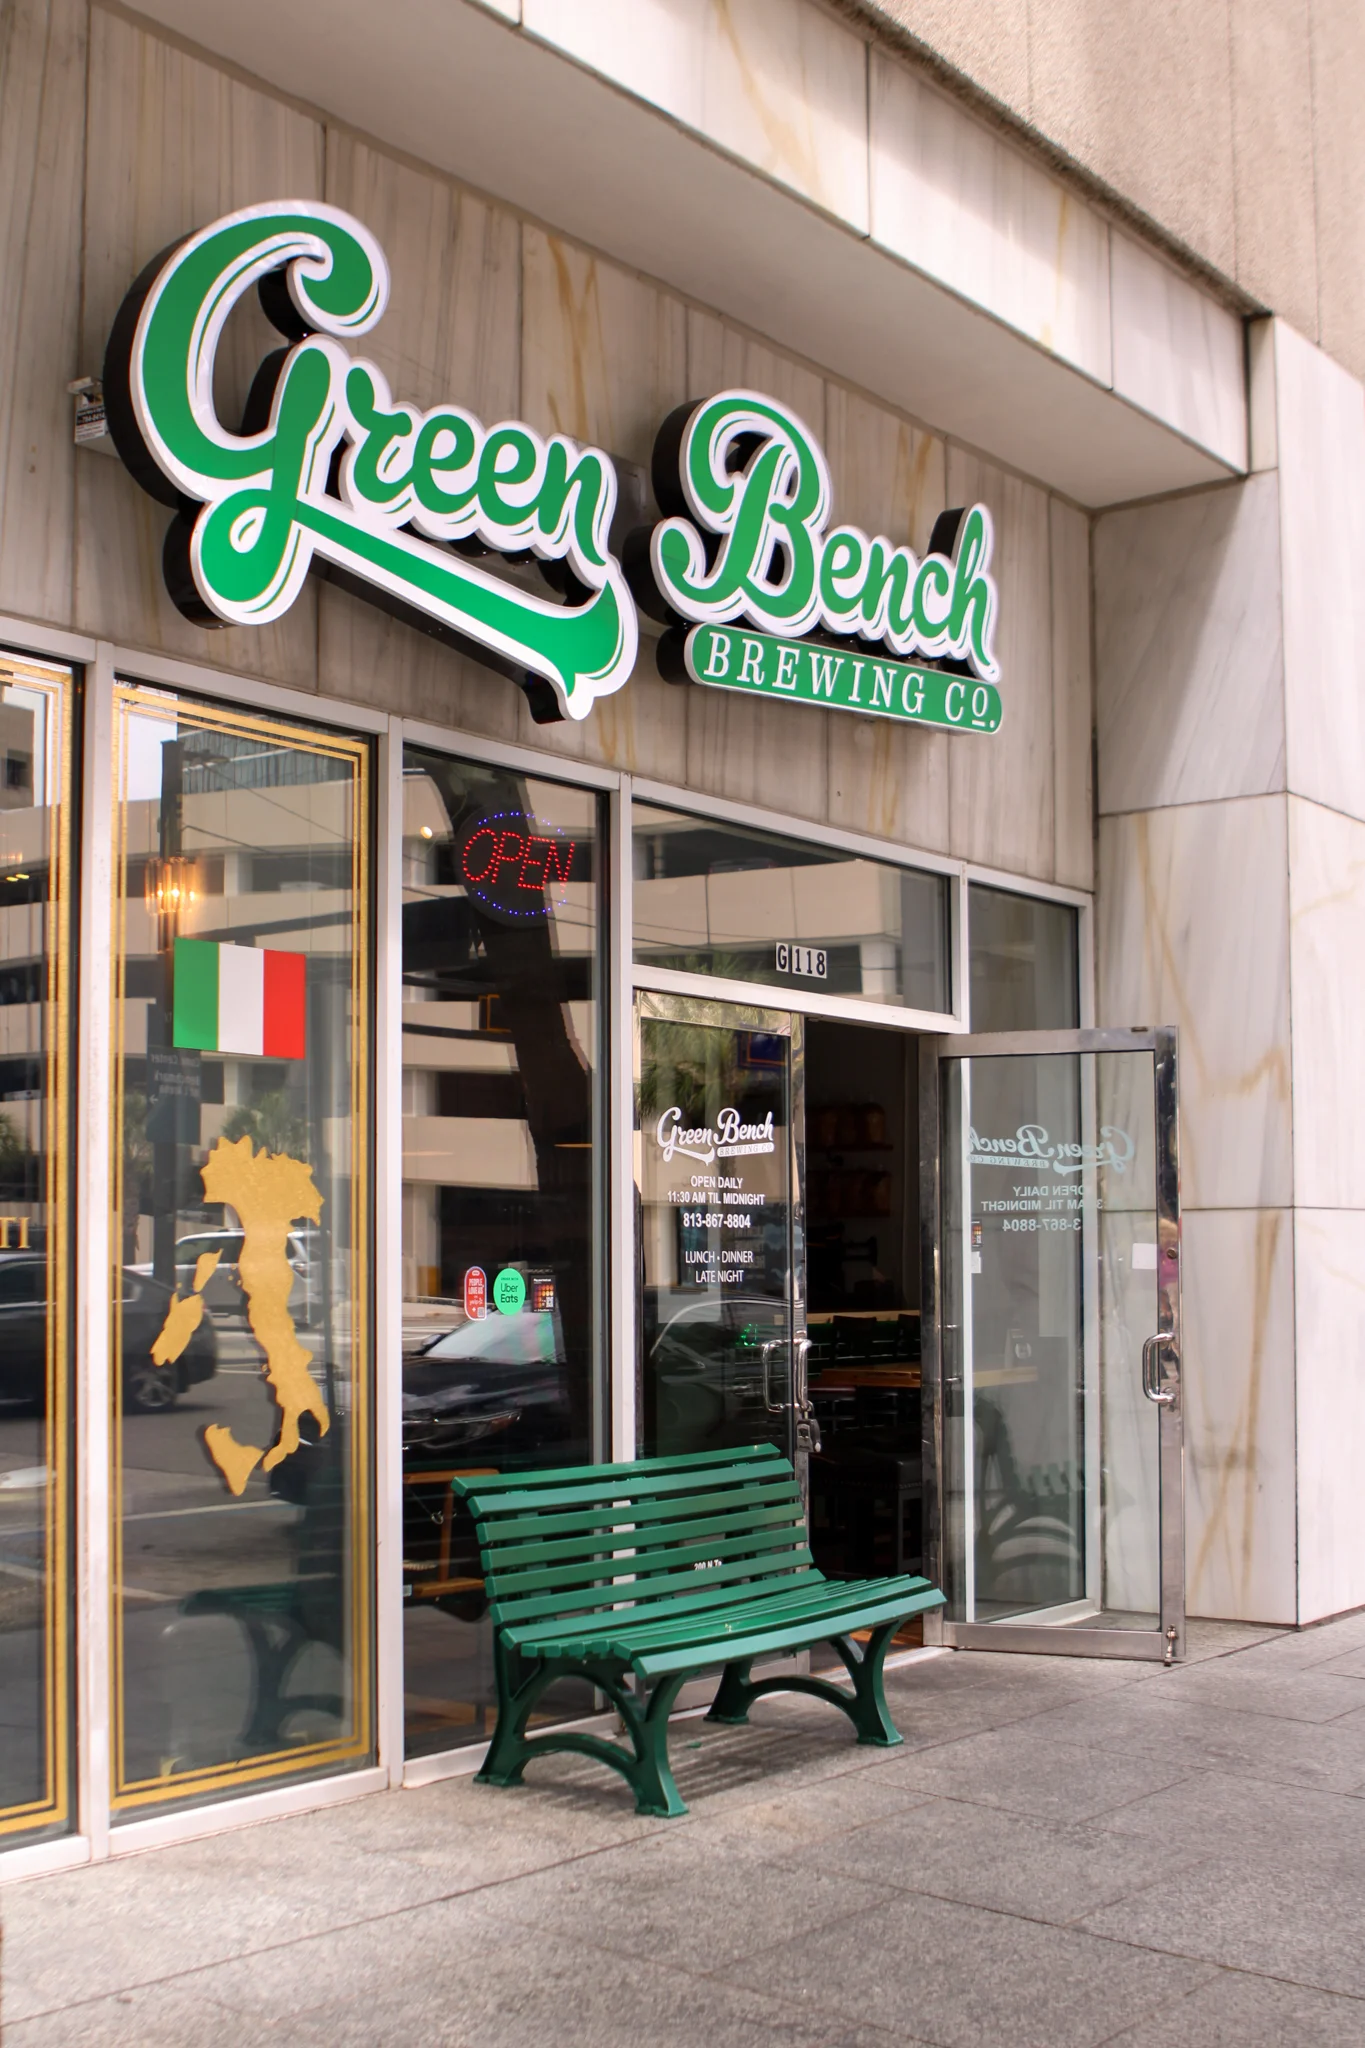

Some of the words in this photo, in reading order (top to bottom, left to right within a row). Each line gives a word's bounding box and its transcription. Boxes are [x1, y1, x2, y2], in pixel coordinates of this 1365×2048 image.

[131, 200, 638, 720] Green
[650, 389, 1001, 683] Bench
[703, 631, 925, 714] BREWING
[462, 828, 575, 893] OPEN
[657, 1106, 715, 1166] Green
[713, 1107, 774, 1145] Bench
[719, 1144, 759, 1156] BREWING
[690, 1175, 716, 1188] OPEN
[718, 1177, 743, 1189] DAILY
[667, 1191, 690, 1203] 11:30
[691, 1192, 706, 1204] AM
[708, 1192, 721, 1204] TIL
[723, 1193, 765, 1206] MIDNIGHT
[683, 1212, 751, 1228] 813-867-8804
[685, 1251, 715, 1263] LUNCH
[721, 1251, 753, 1263] DINNER
[695, 1271, 716, 1283] LATE
[718, 1270, 744, 1283] NIGHT
[501, 1283, 518, 1292] Uber
[500, 1294, 518, 1303] Eats
